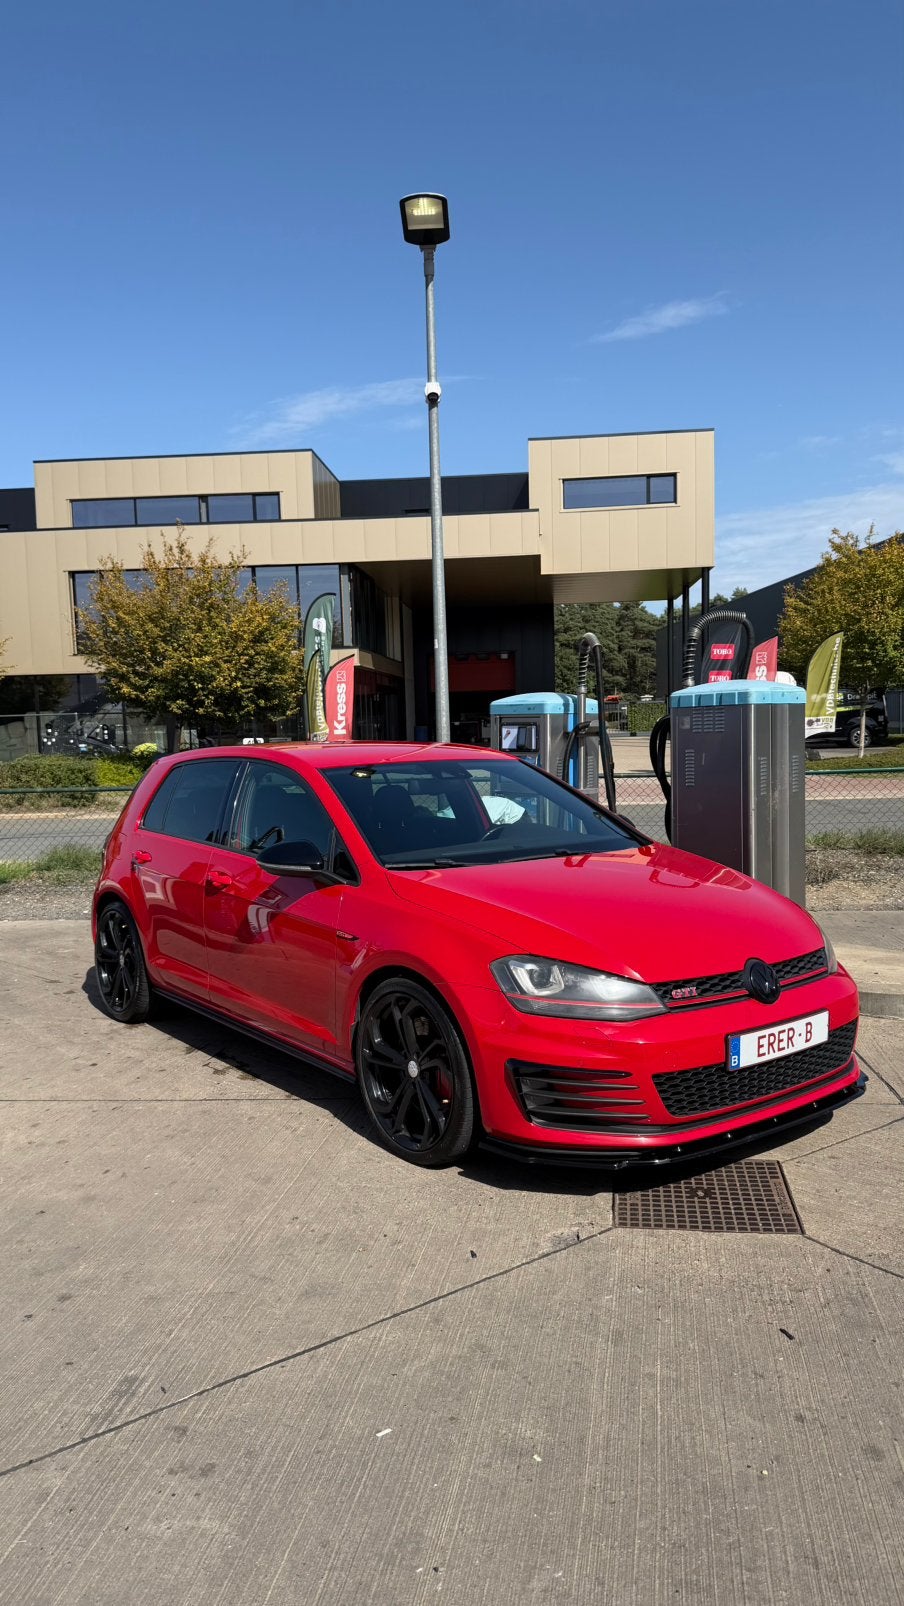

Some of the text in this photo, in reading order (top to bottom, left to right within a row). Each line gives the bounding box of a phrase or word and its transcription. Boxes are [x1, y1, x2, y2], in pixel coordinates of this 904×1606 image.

[333, 683, 347, 735] Kress
[671, 986, 698, 999] GTI
[731, 1055, 739, 1067] B
